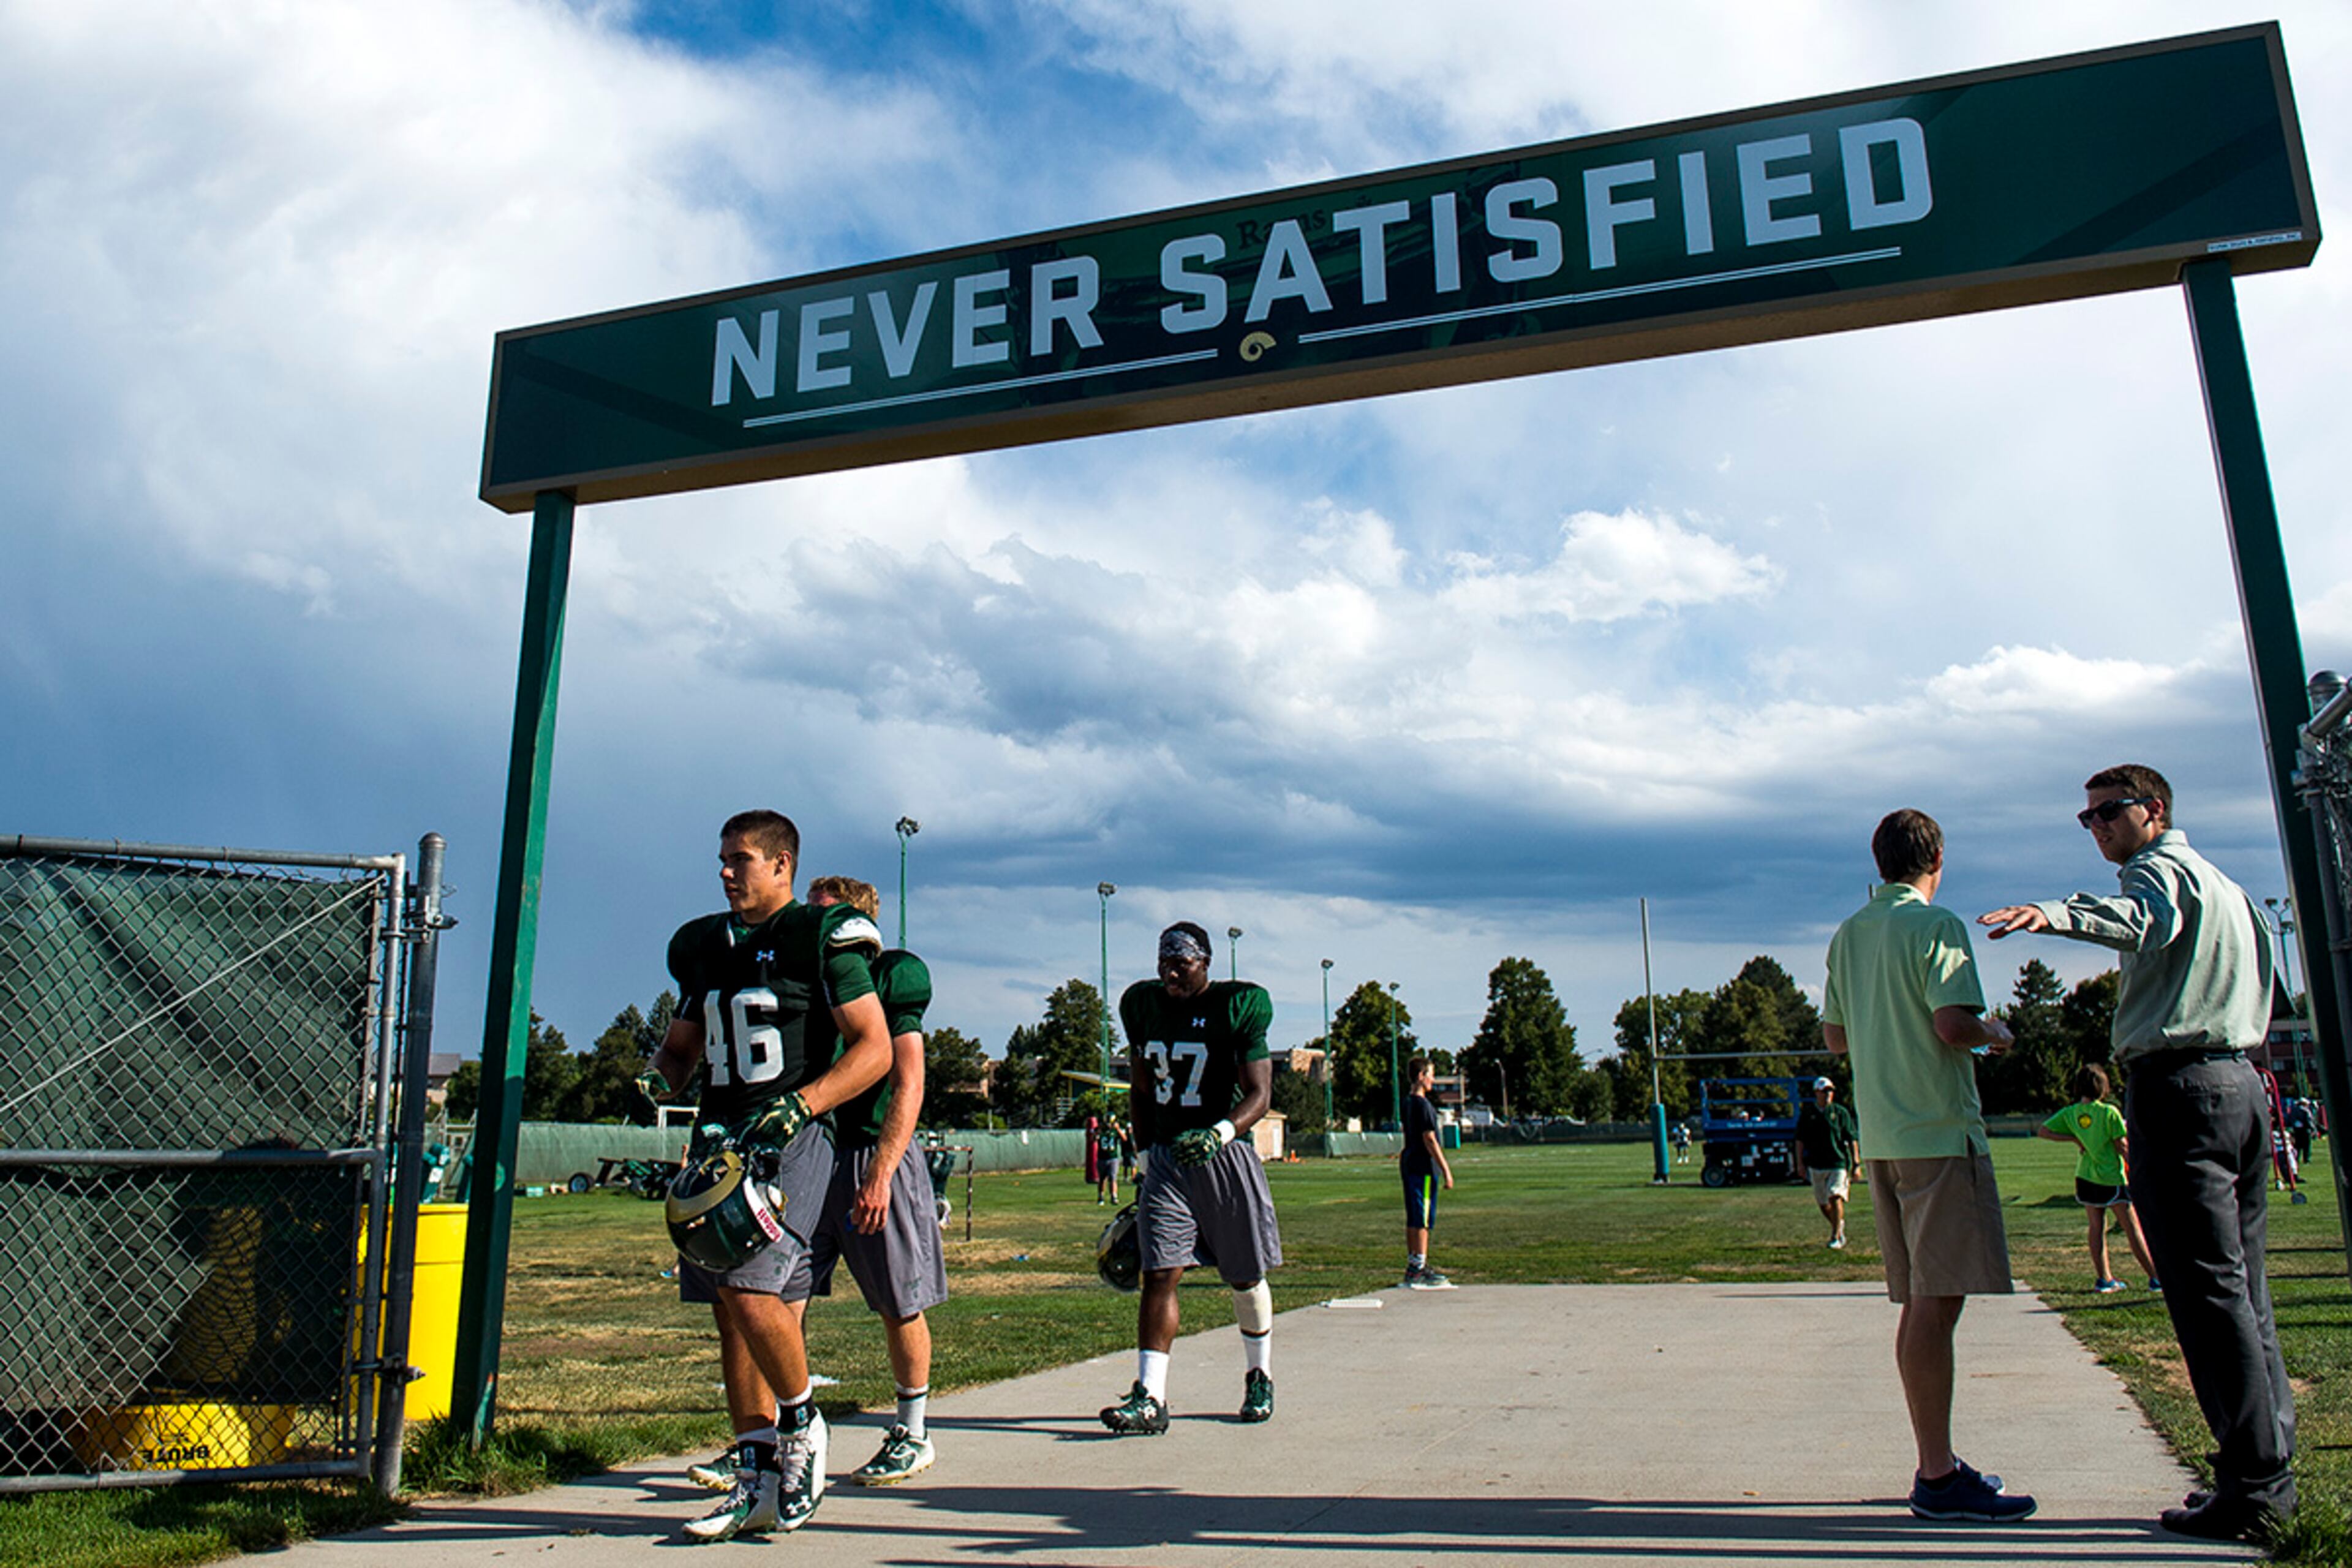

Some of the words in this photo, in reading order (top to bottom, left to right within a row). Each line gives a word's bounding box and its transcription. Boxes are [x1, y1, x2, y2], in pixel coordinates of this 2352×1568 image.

[710, 255, 1104, 407] NEVER
[1160, 116, 1934, 334] SATISFIED
[1235, 209, 1327, 250] Ras
[703, 987, 785, 1087] 46
[1144, 1041, 1208, 1106] 37
[137, 1444, 209, 1463] BRUTE
